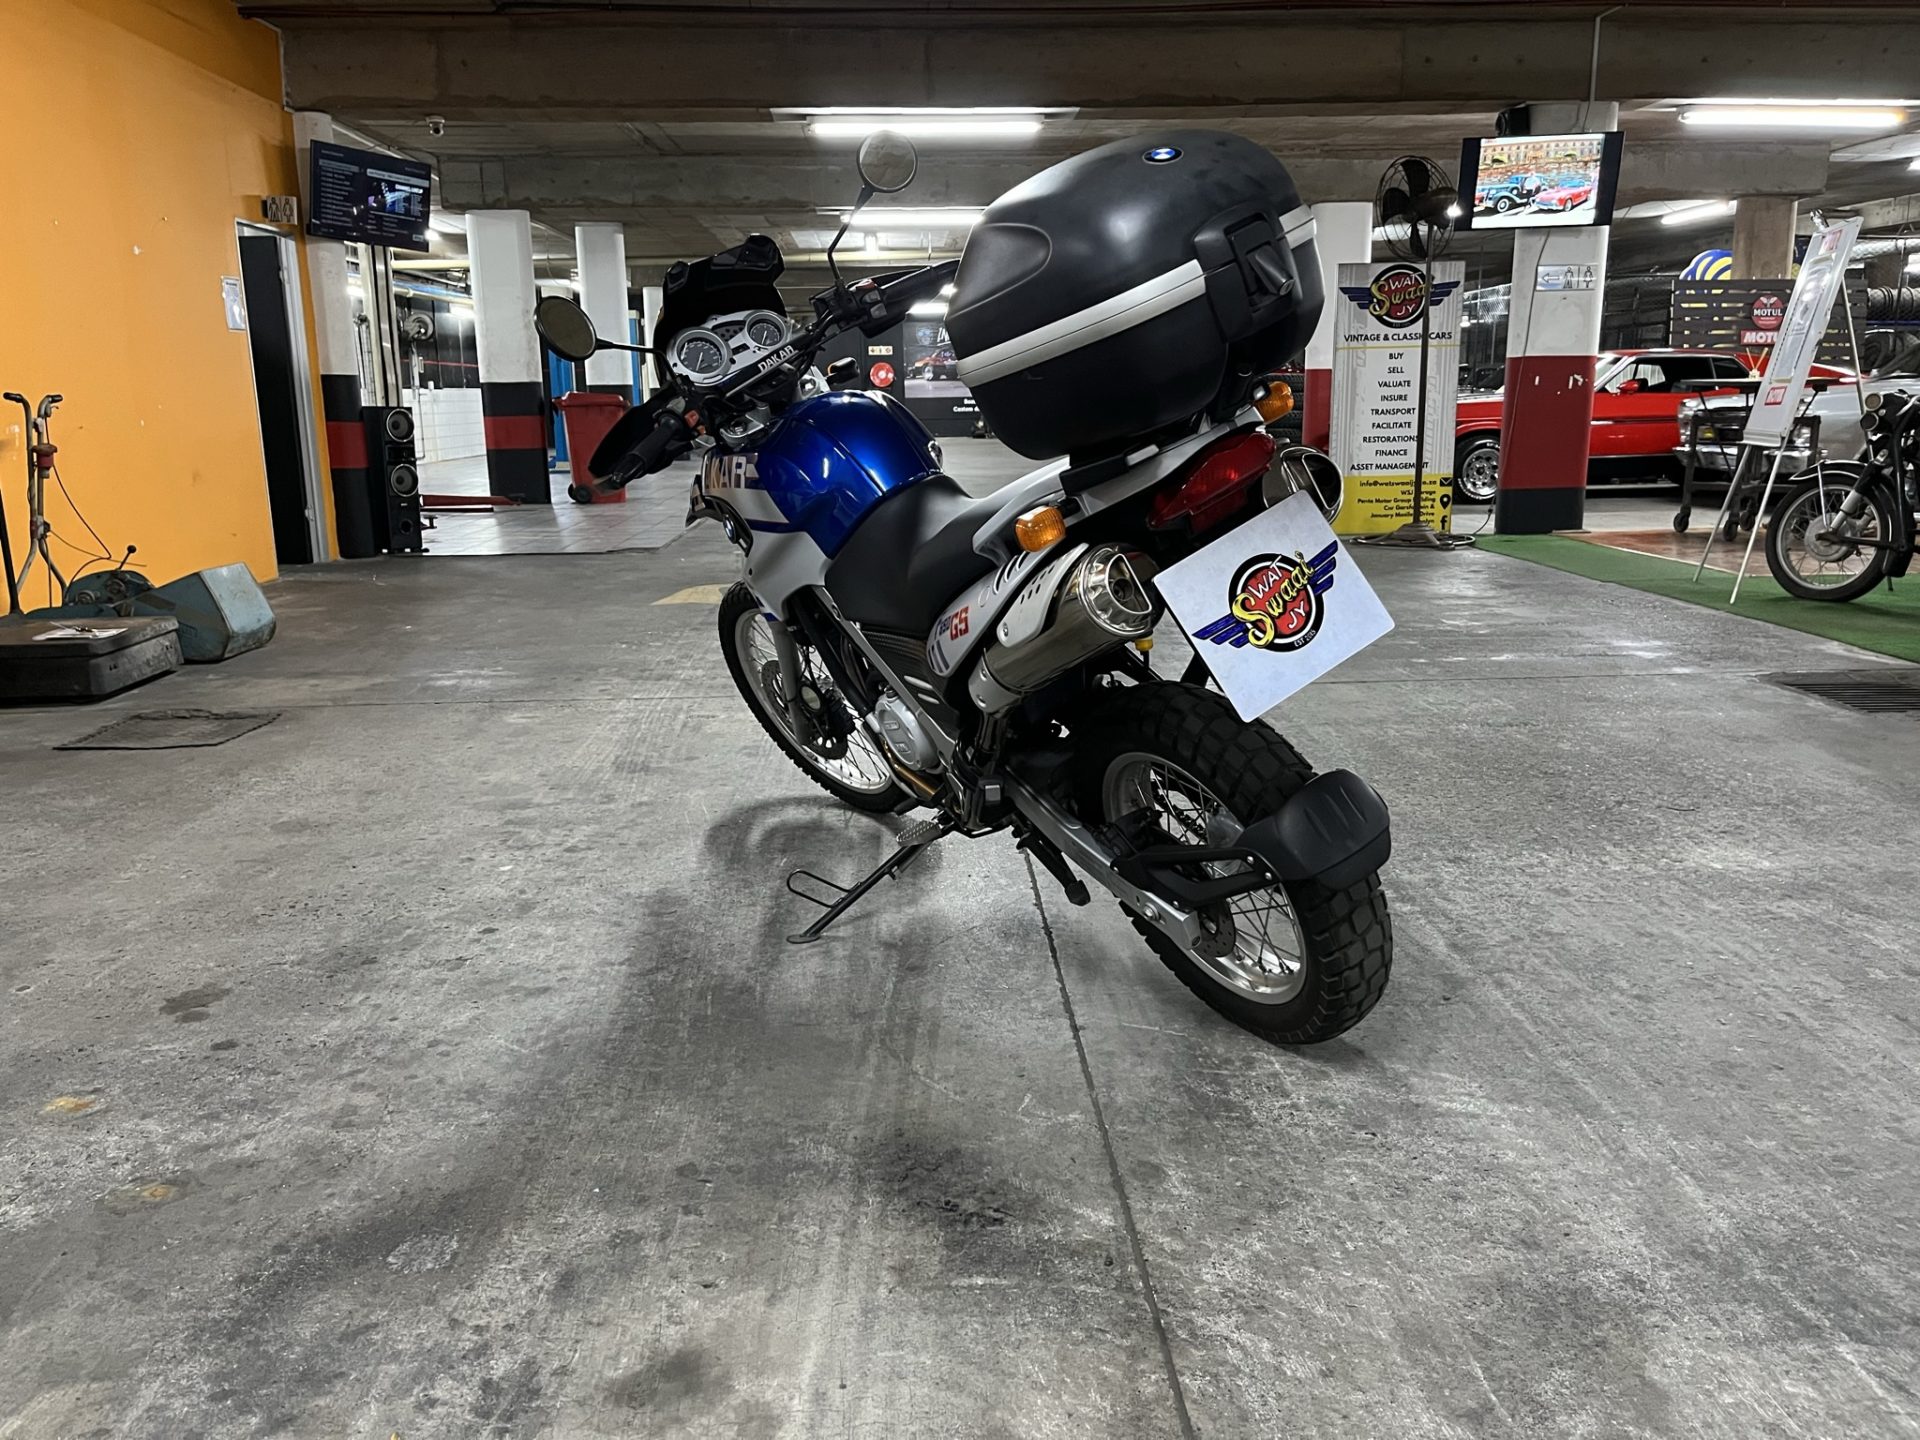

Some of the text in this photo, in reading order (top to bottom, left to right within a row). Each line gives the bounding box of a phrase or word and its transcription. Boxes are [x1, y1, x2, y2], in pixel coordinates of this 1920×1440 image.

[1388, 272, 1422, 290] WAT
[1396, 303, 1416, 316] JY
[1753, 308, 1783, 316] MOTUL
[1344, 331, 1453, 342] VINTAGE & CLASSI CARS
[1388, 352, 1404, 360] BUY
[1387, 366, 1405, 374] SELL
[1377, 380, 1412, 388] VALUATE
[1380, 394, 1408, 402] INSURE
[1371, 407, 1416, 416] TRANSPORT
[1372, 421, 1412, 429] FACILITATE
[1375, 449, 1408, 457] FINANCE
[1350, 463, 1374, 471] ASSET
[1247, 555, 1283, 599] WAT
[1288, 600, 1306, 629] JY
